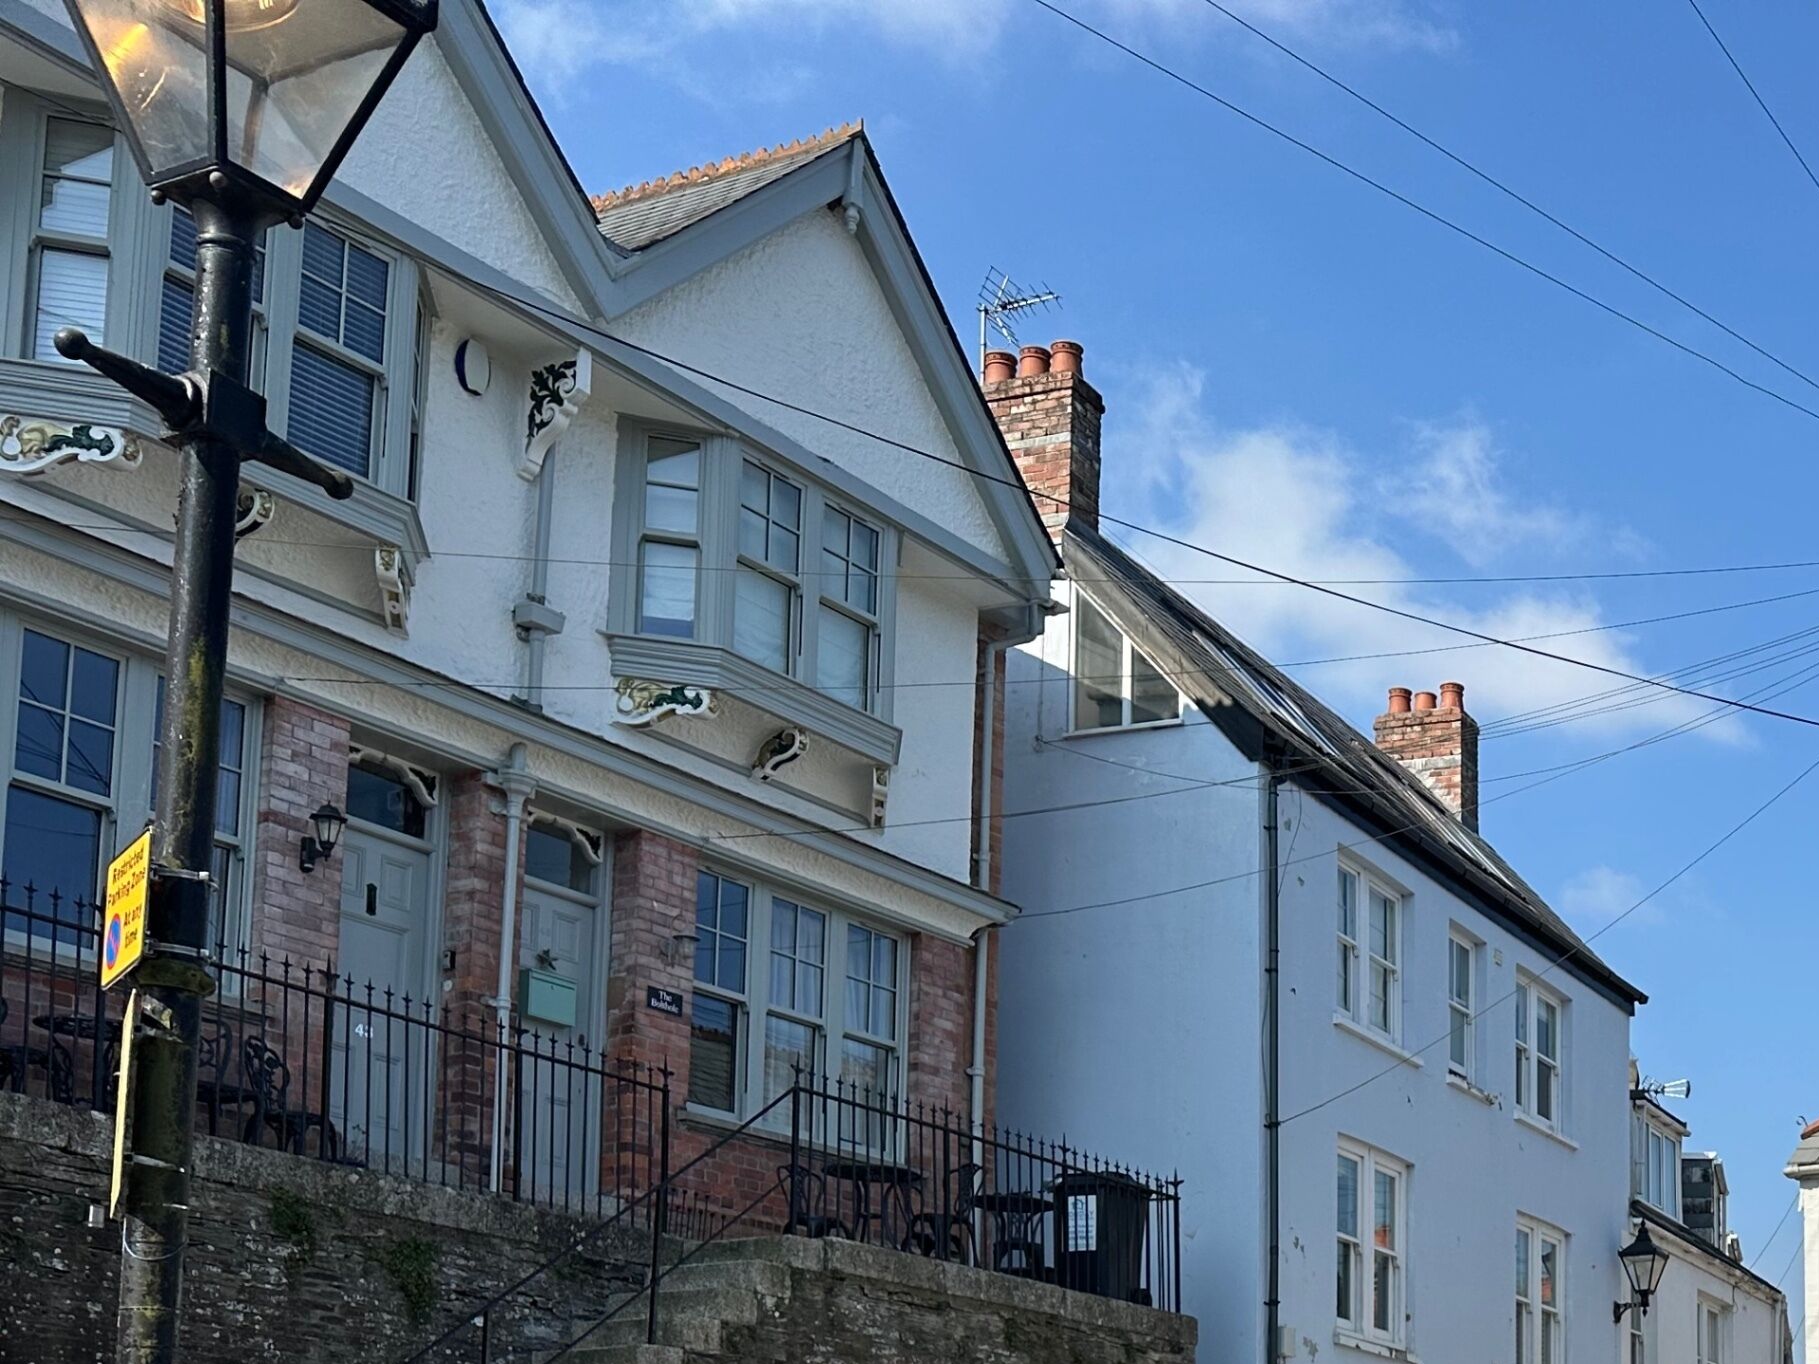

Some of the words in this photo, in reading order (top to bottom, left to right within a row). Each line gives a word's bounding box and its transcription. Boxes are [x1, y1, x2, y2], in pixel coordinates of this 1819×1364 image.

[113, 843, 145, 884] Restricted
[108, 880, 131, 909] Parking
[131, 867, 146, 889] Zone
[124, 910, 131, 926] At
[131, 902, 143, 921] any
[125, 928, 138, 949] time
[658, 990, 673, 1002] The
